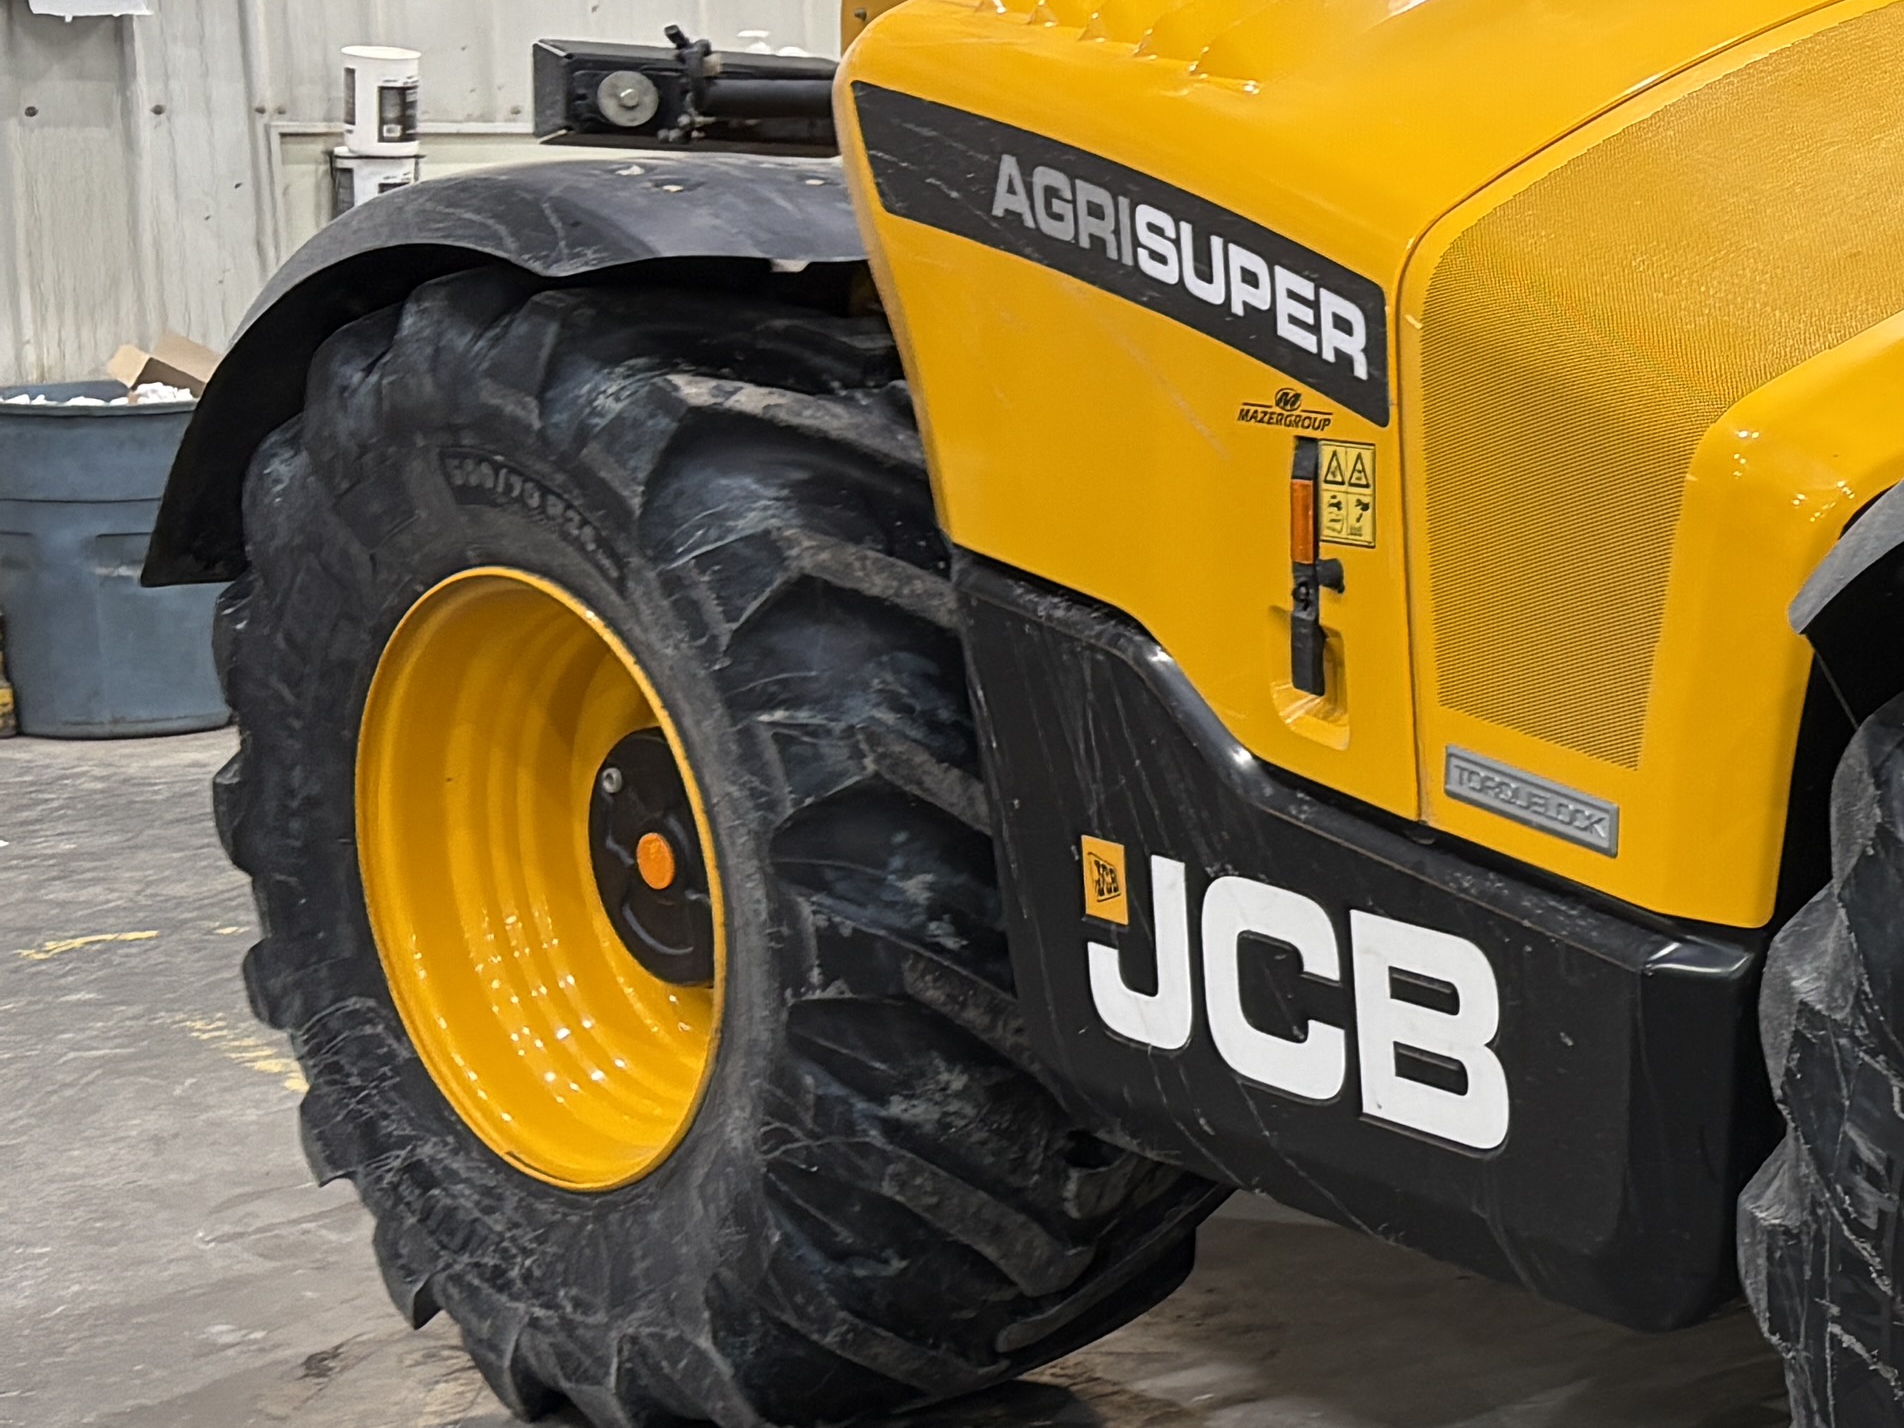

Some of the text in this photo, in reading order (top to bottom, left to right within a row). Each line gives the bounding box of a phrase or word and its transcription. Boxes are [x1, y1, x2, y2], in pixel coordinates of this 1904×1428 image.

[991, 154, 1368, 381] AGRISUPER
[1237, 408, 1332, 432] MAZERGROUP
[1454, 764, 1607, 839] TORQUELOCK
[1094, 859, 1120, 897] JCB
[1087, 854, 1510, 1151] JCB
